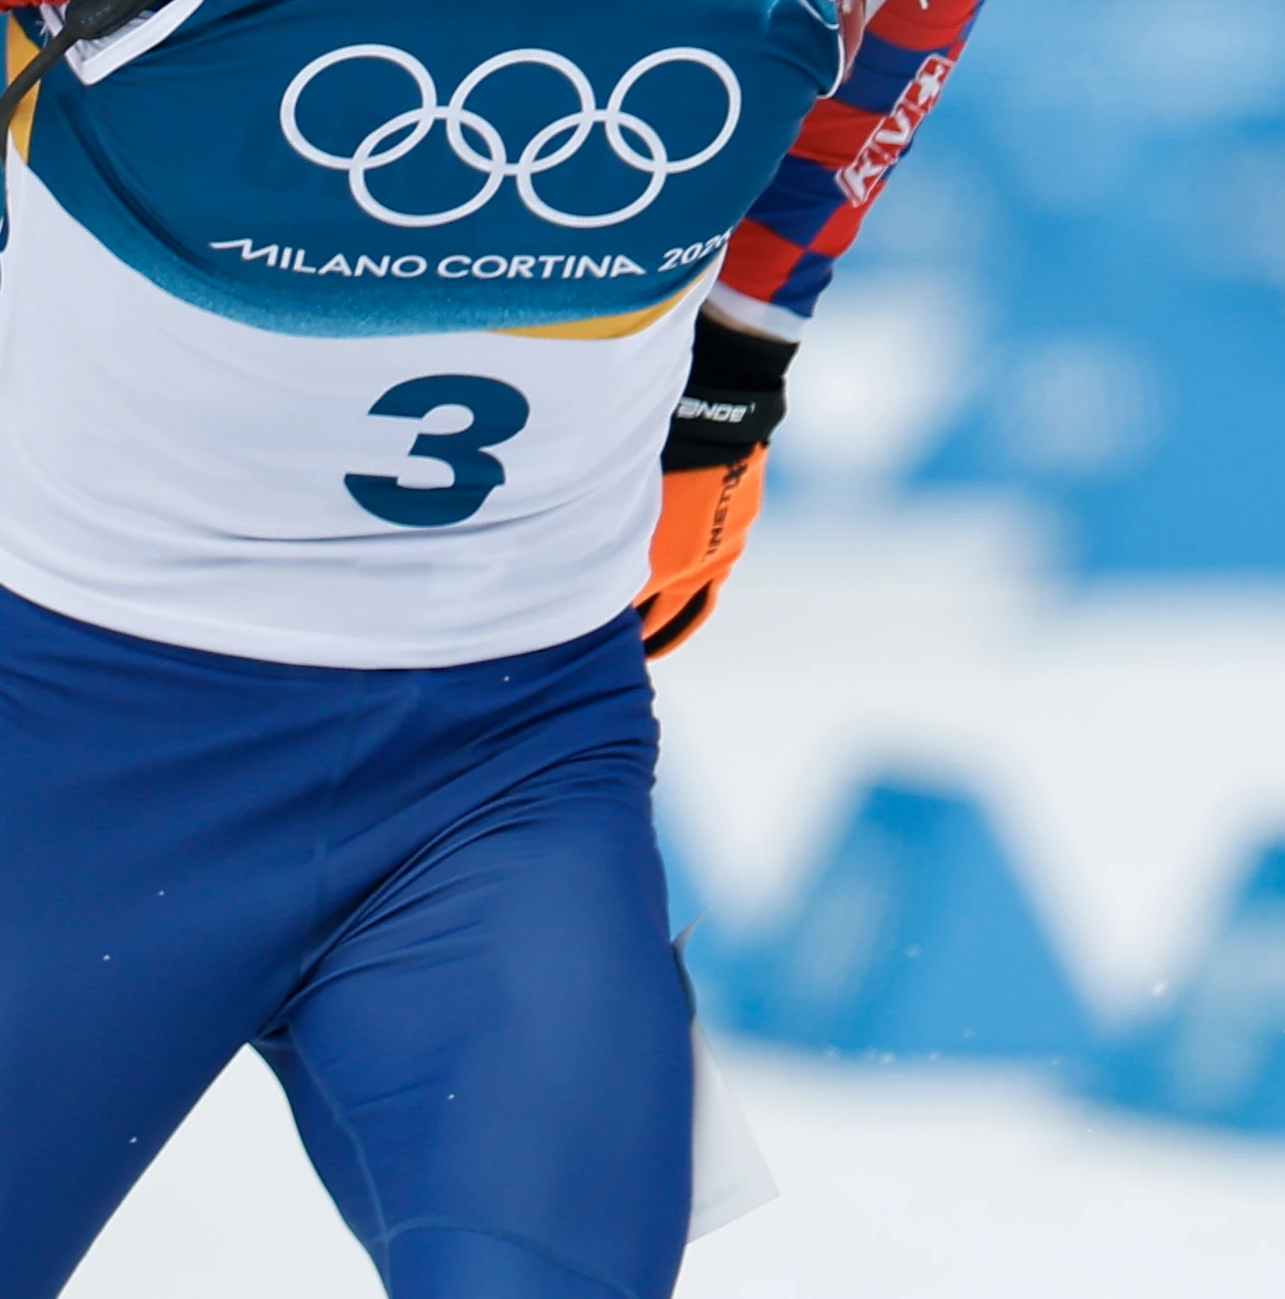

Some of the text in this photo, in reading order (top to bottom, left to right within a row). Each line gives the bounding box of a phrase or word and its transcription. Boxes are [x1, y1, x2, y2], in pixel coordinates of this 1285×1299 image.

[209, 238, 428, 278] MILANO
[437, 254, 647, 279] CORTINA
[344, 374, 530, 528] 3
